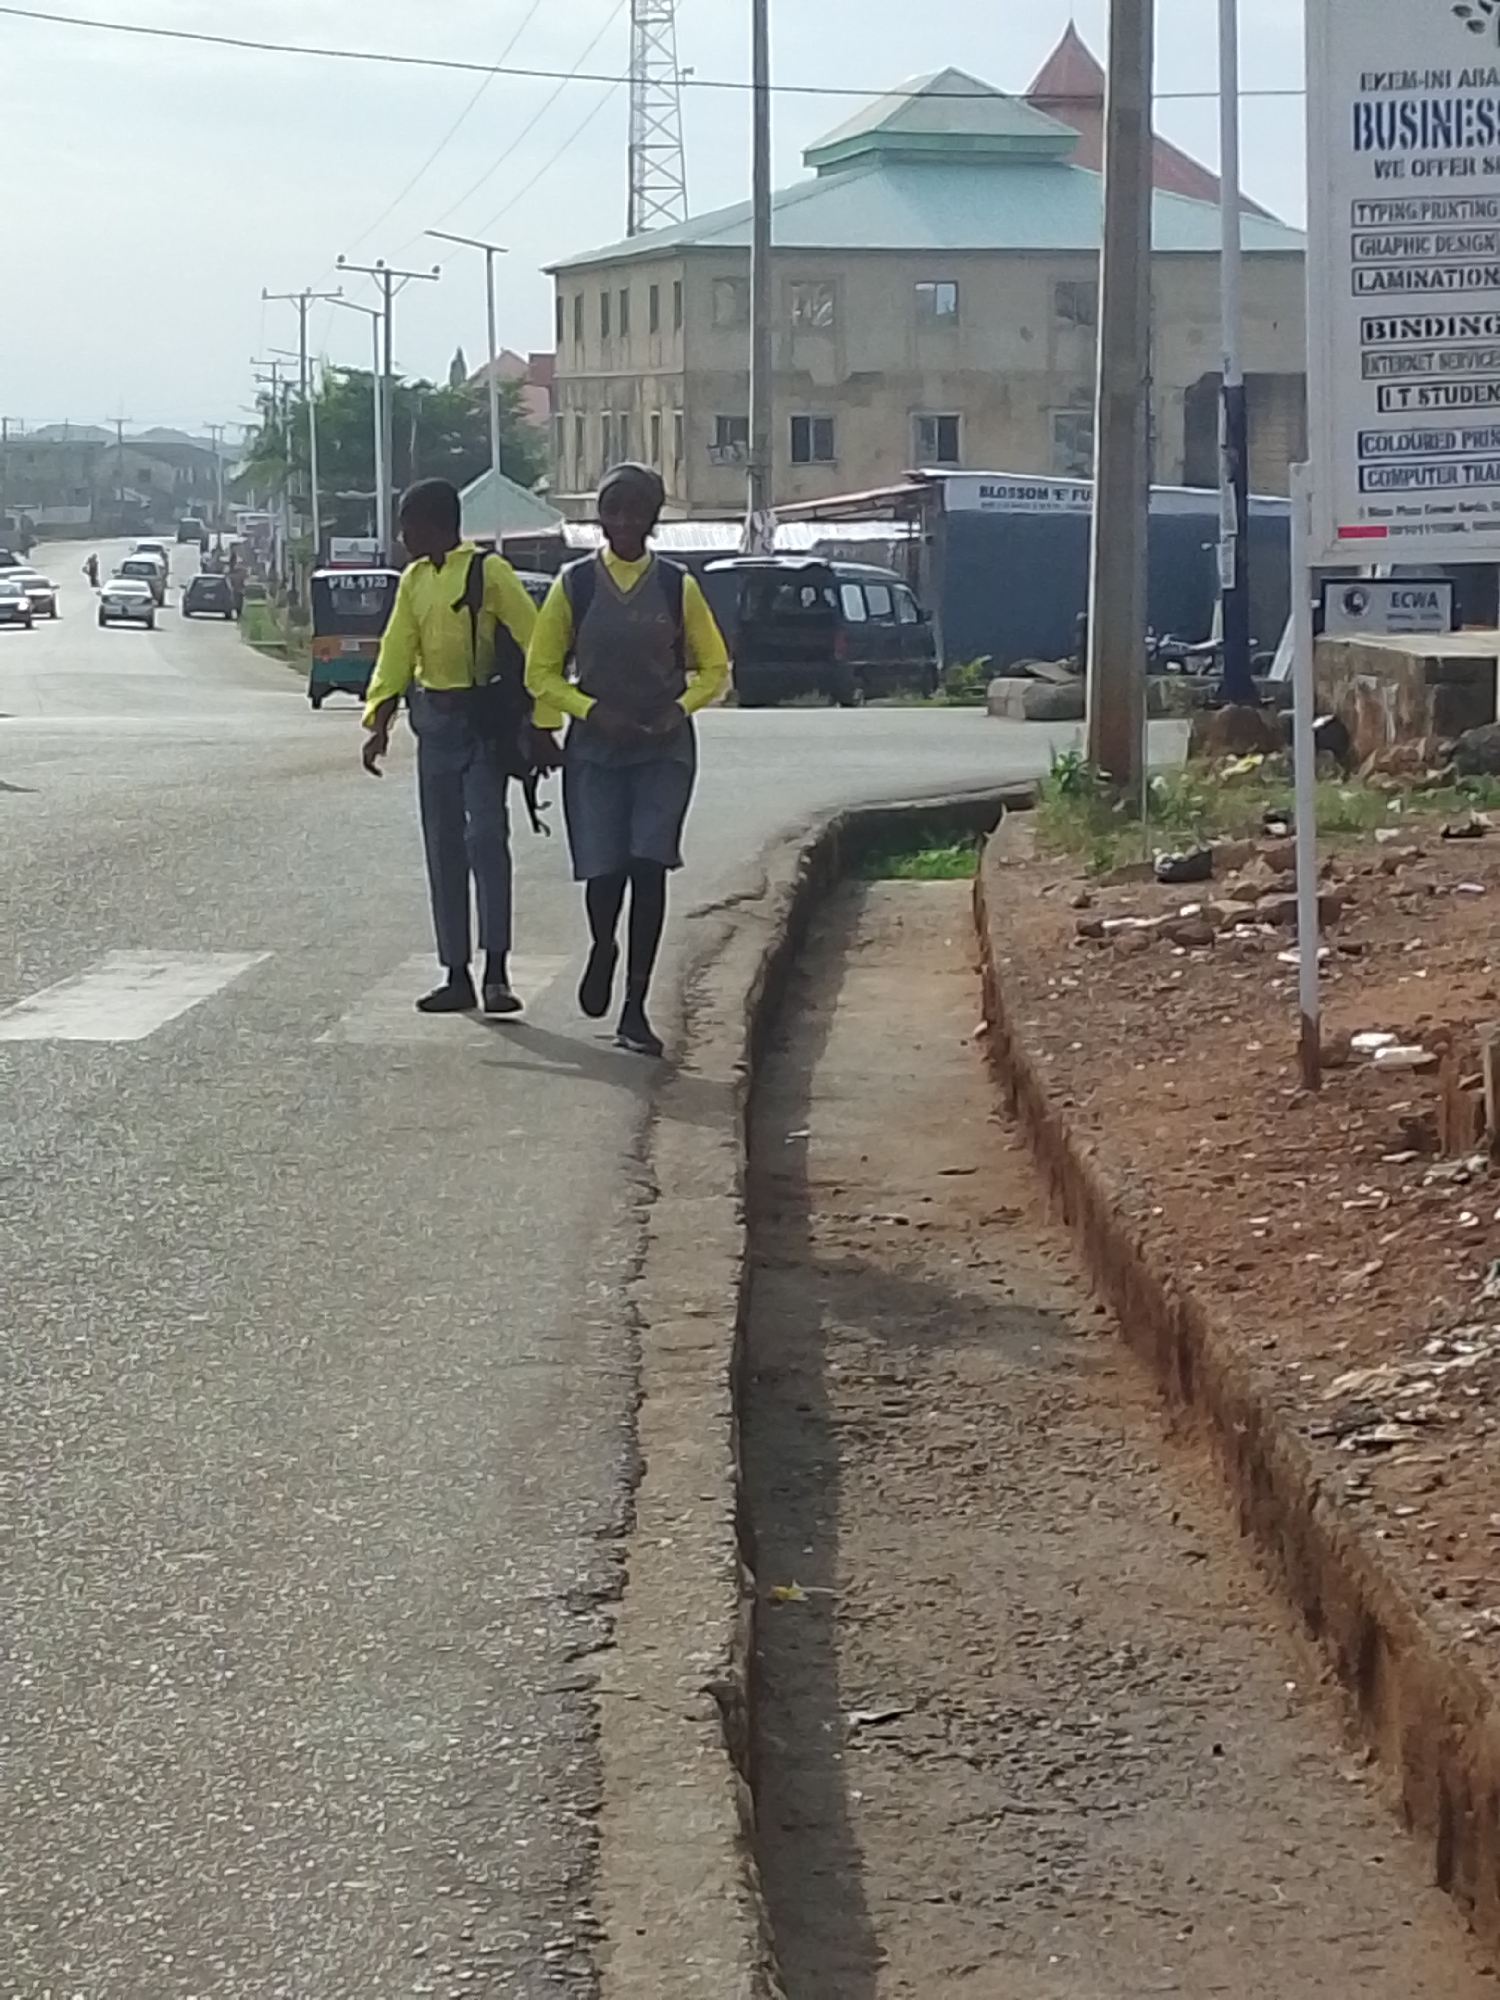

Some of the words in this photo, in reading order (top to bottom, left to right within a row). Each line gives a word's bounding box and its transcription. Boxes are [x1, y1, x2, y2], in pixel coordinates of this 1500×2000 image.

[1353, 98, 1500, 151] BUSINES
[1374, 158, 1406, 179] WE
[1411, 156, 1476, 177] OFFER
[1357, 201, 1418, 223] TYPING
[1420, 199, 1499, 220] PRINTING
[1359, 235, 1431, 256] GRAPHIC
[1358, 266, 1500, 290] LAMINATION
[1364, 431, 1456, 454] COLOURED
[1368, 466, 1458, 487] COMPUTER
[1391, 591, 1439, 609] ECWA
